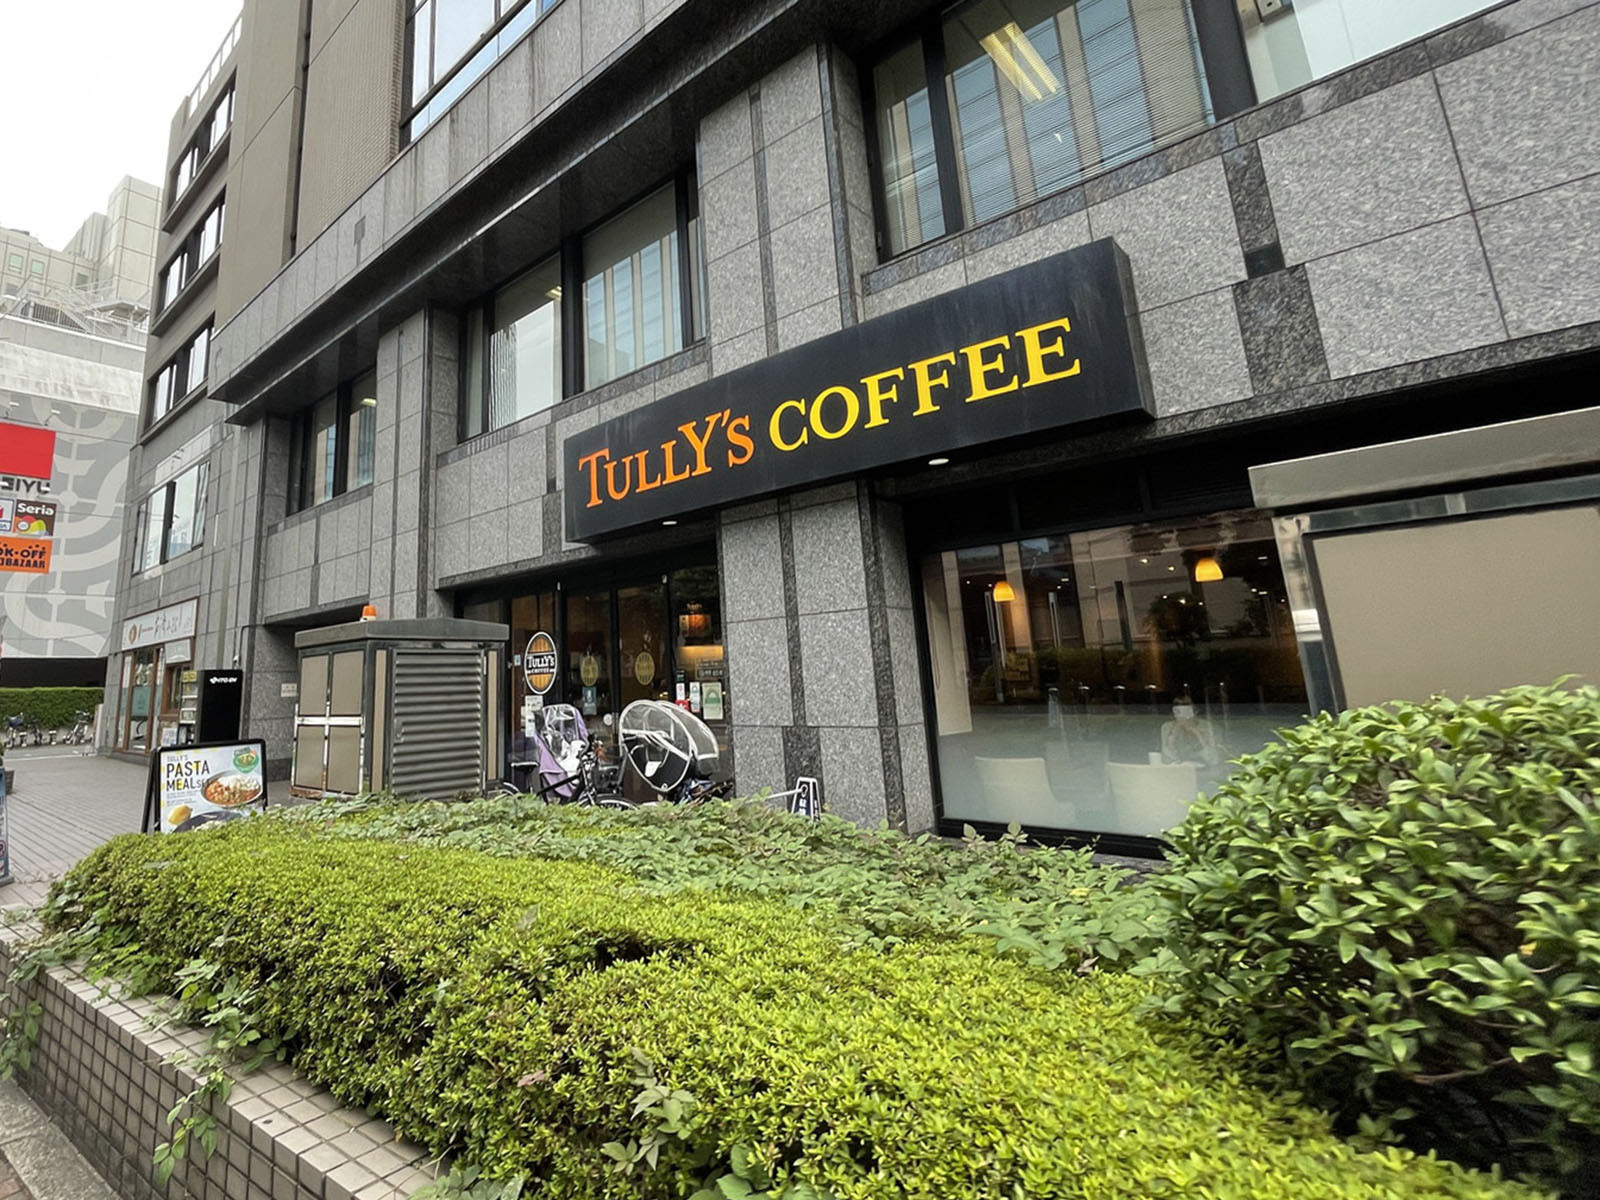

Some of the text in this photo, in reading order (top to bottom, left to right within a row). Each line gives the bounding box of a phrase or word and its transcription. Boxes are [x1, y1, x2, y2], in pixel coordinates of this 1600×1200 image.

[578, 318, 1080, 507] TULLY'S COFFEE
[17, 503, 54, 515] Seria
[166, 760, 210, 778] PASTA
